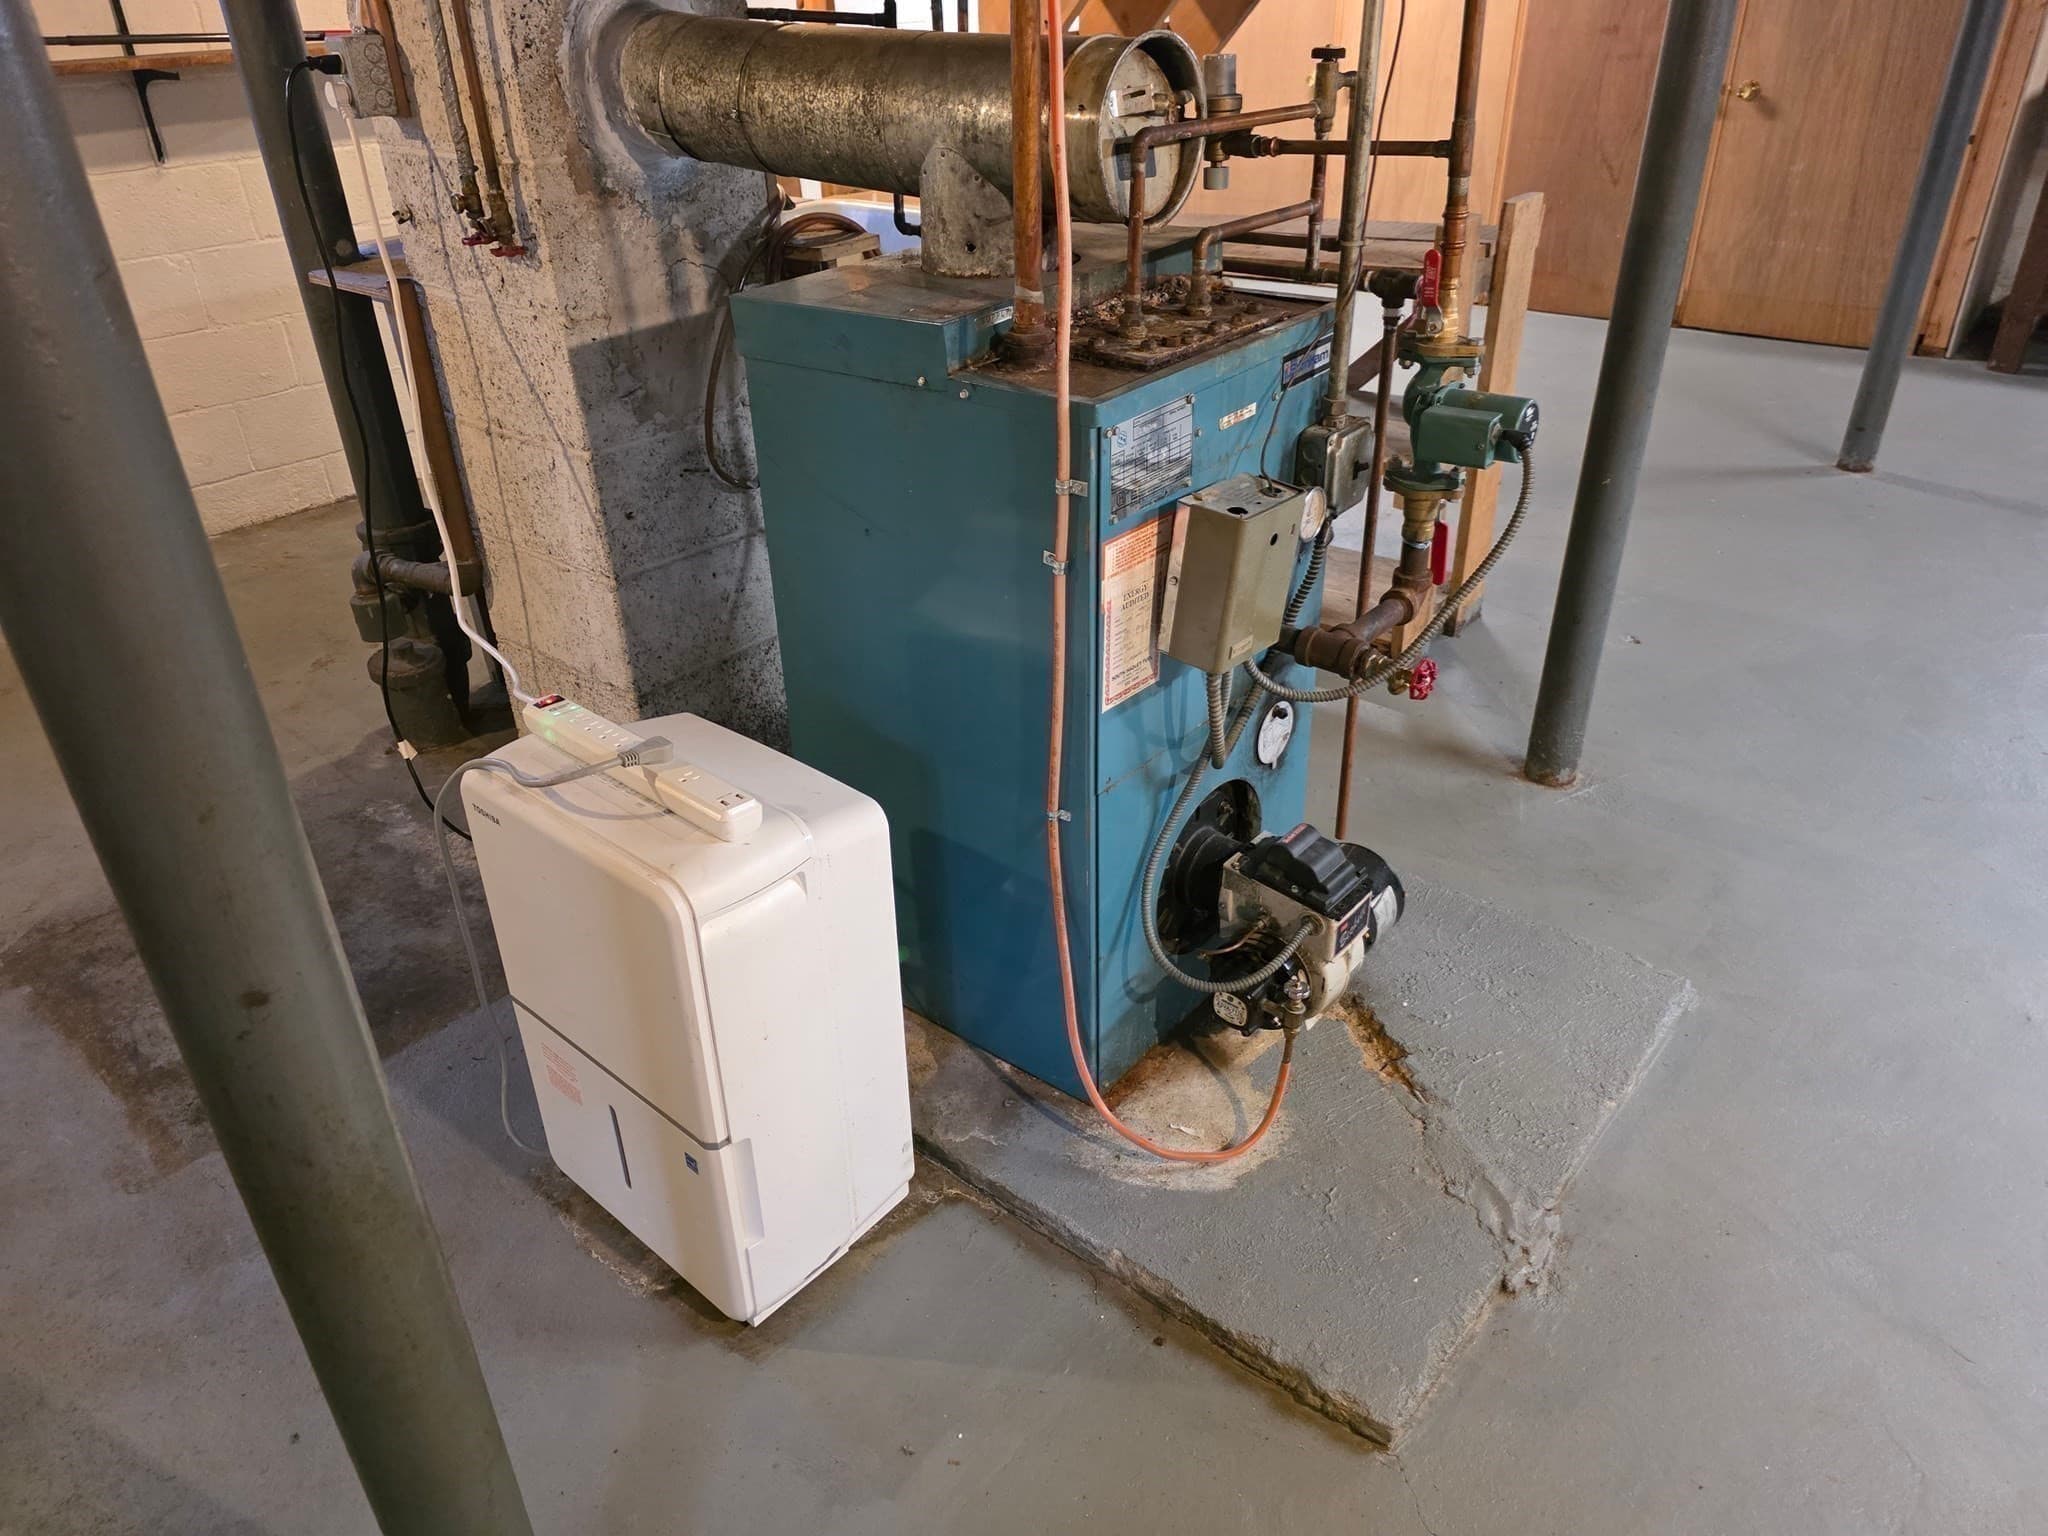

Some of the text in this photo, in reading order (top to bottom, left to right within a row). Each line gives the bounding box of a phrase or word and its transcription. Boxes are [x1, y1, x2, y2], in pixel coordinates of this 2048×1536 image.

[1120, 592, 1149, 611] AUDITED
[1122, 584, 1148, 602] ENERGY
[472, 803, 501, 826] TOSHIBA
